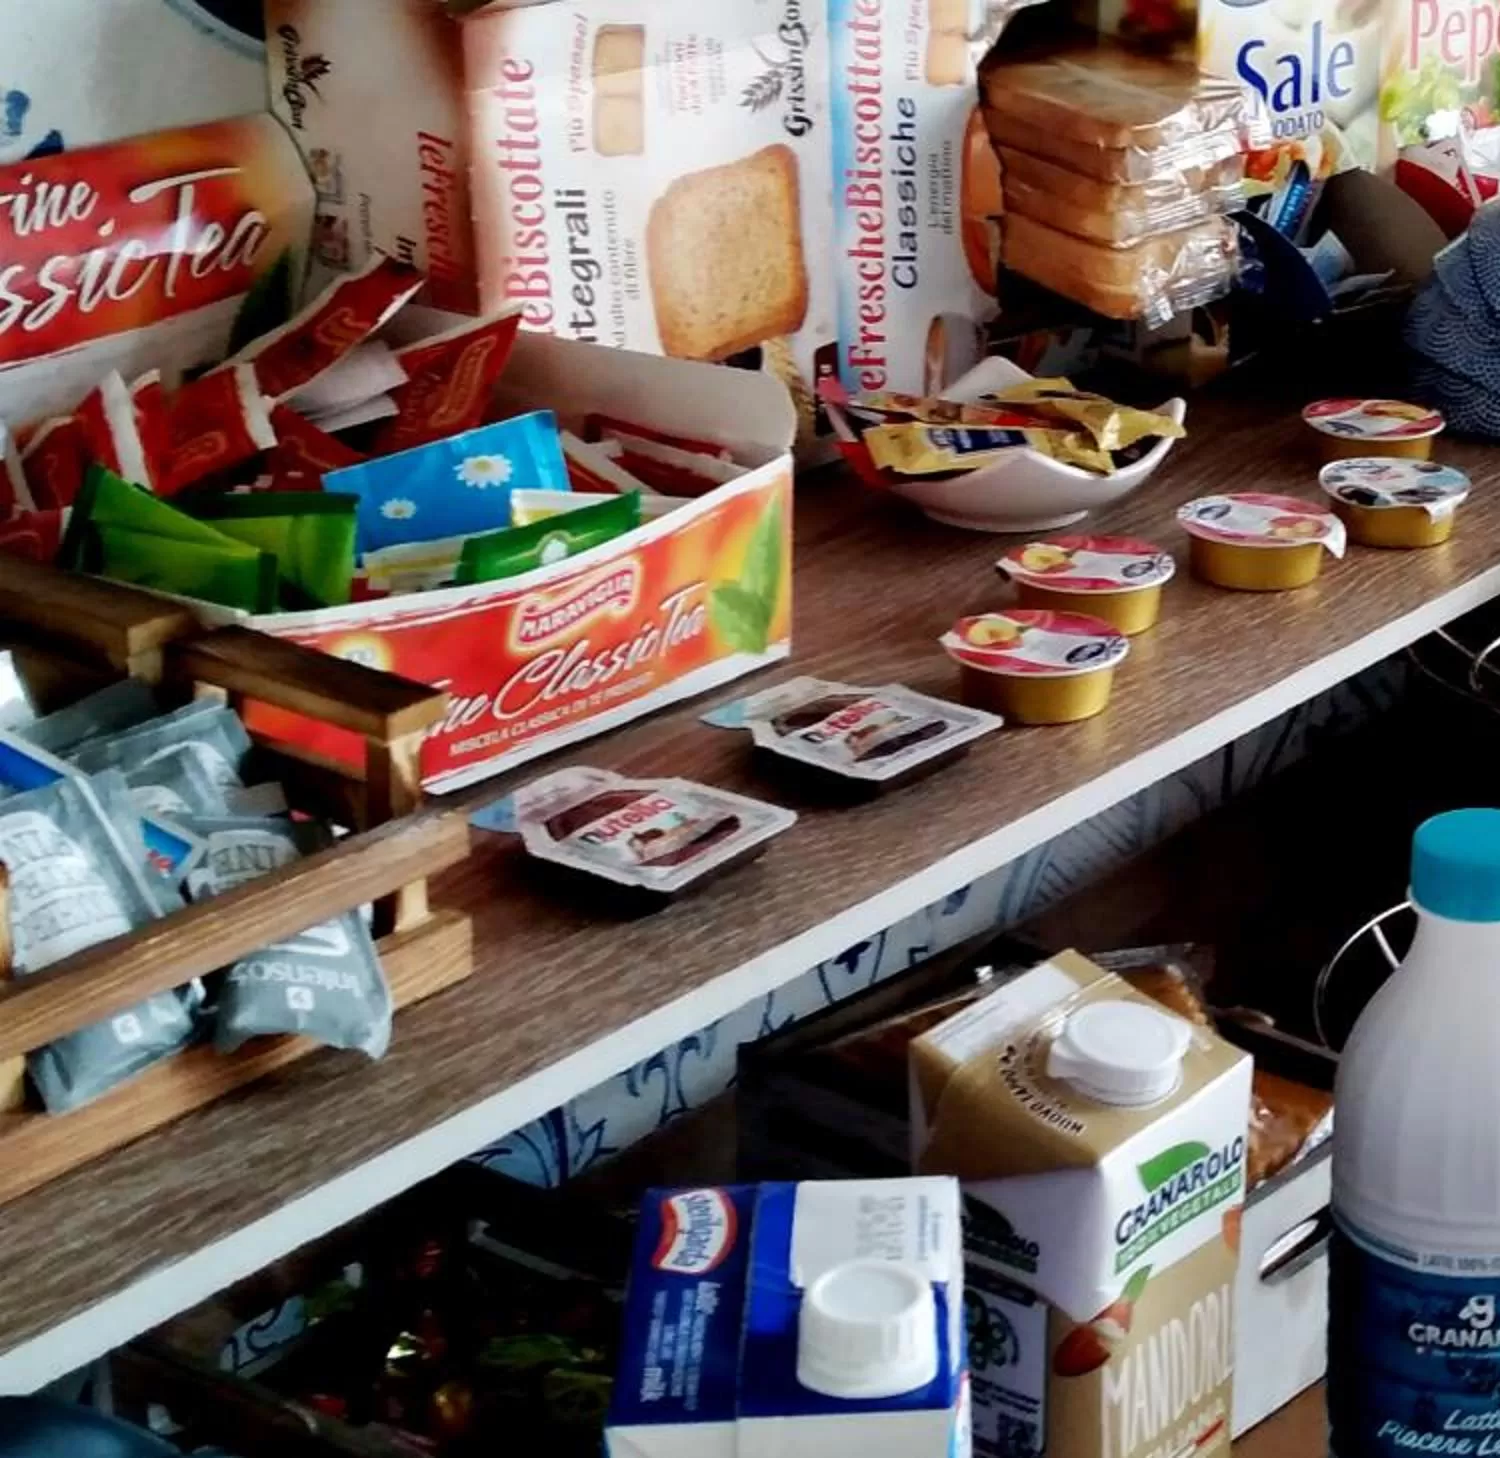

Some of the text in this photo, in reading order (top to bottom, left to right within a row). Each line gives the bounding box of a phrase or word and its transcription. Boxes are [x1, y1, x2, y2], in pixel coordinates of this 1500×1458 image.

[1236, 20, 1355, 113] Sale
[1272, 110, 1324, 139] ODATO
[0, 173, 98, 238] ine
[498, 56, 556, 337] eBiscottate
[846, 0, 888, 392] eFrescheBiscottate
[891, 97, 918, 289] Classiche
[553, 188, 603, 344] tegrali
[521, 568, 635, 638] MARAVIGLIA
[801, 698, 890, 746] nutella
[580, 796, 676, 846] nutella
[1115, 1136, 1244, 1246] GRANAROLO
[1377, 1420, 1476, 1456] Piacere
